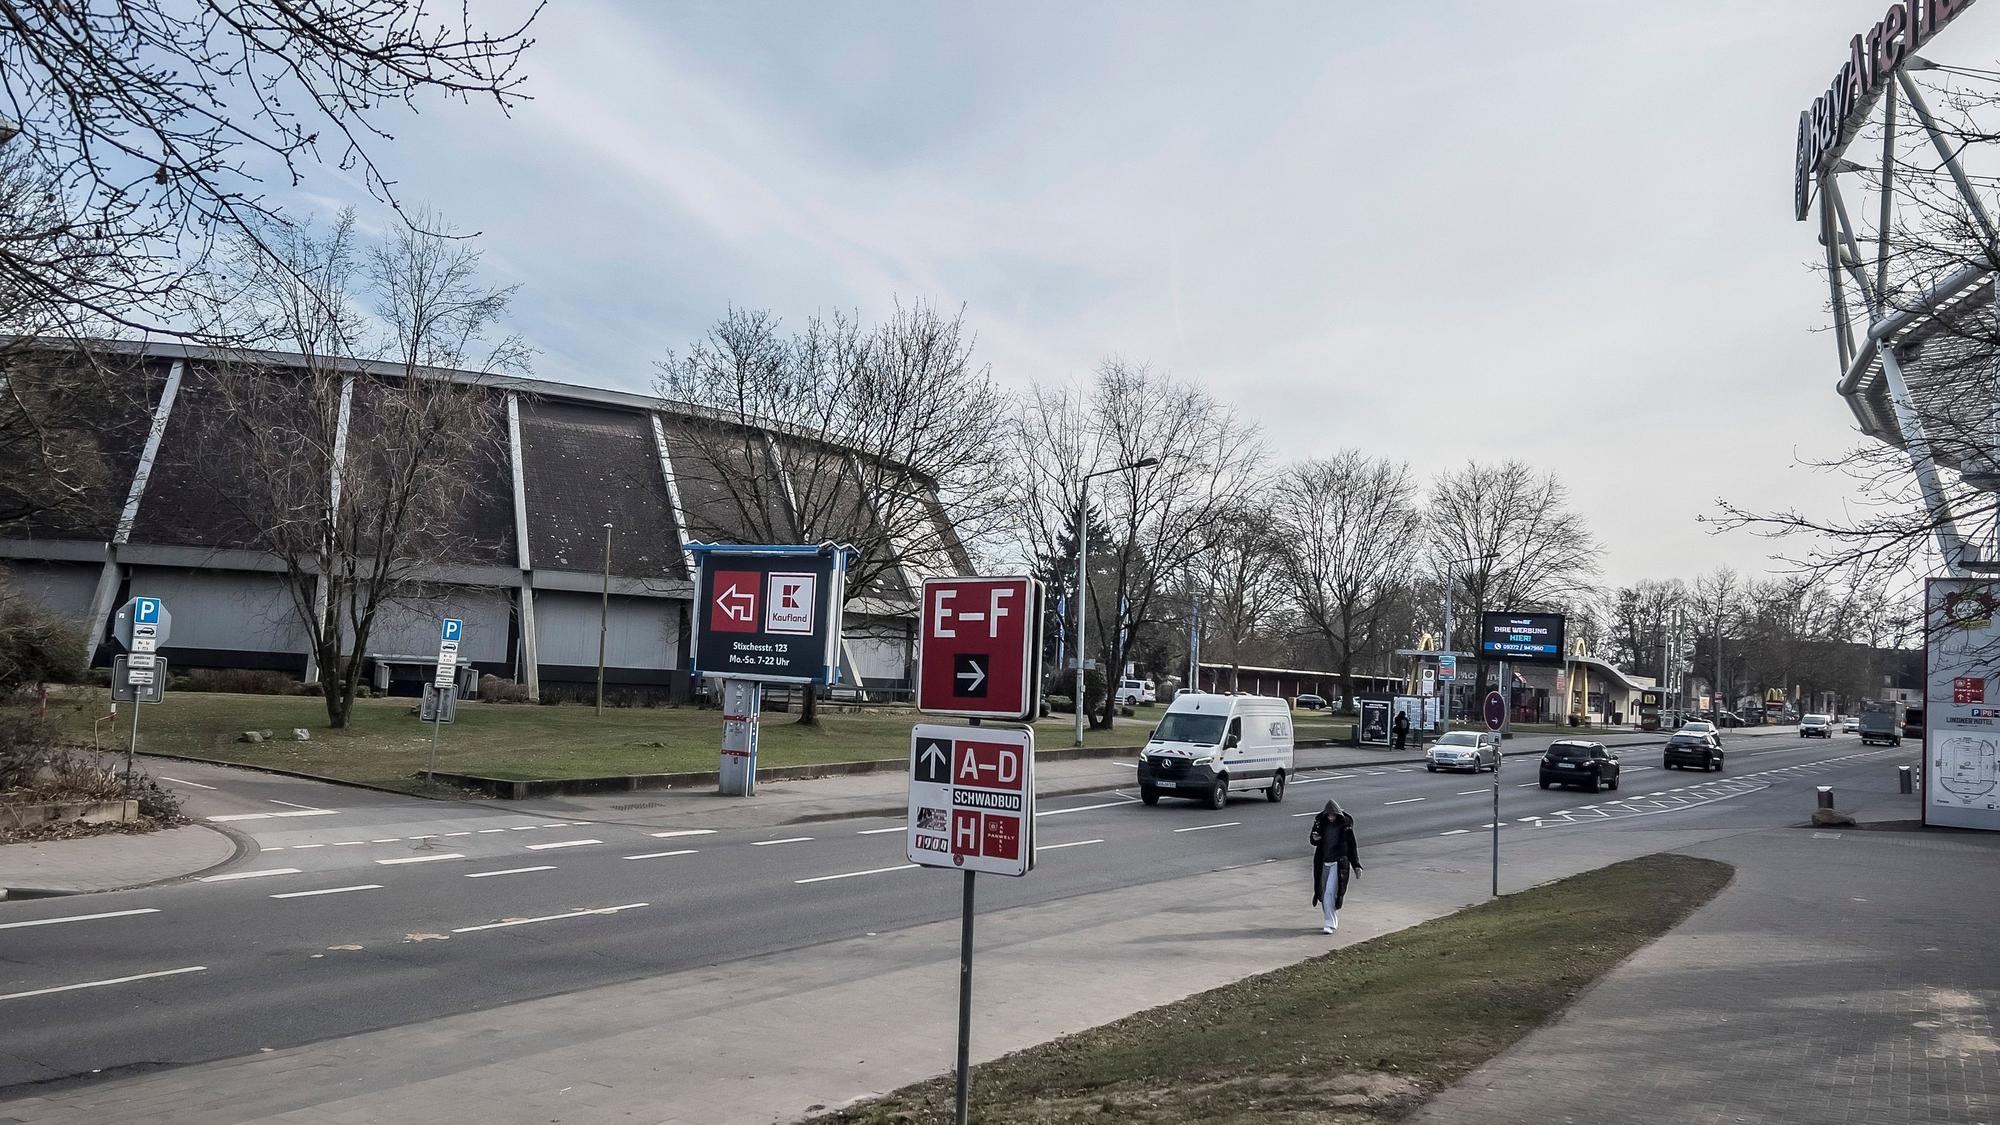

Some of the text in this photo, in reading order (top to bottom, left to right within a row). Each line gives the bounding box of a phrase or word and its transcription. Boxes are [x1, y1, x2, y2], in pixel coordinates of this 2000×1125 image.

[140, 600, 155, 621] P
[772, 613, 808, 623] Kaufland
[933, 588, 1015, 638] E-F
[446, 622, 457, 638] P
[733, 641, 788, 652] Stixchesstr. 123
[729, 654, 790, 666] Mo.-Sa. 7-22 Uhr
[960, 748, 1018, 783] A-D
[954, 791, 1020, 809] SCHWADBUD
[956, 816, 976, 849] H
[917, 835, 947, 851] 1904
